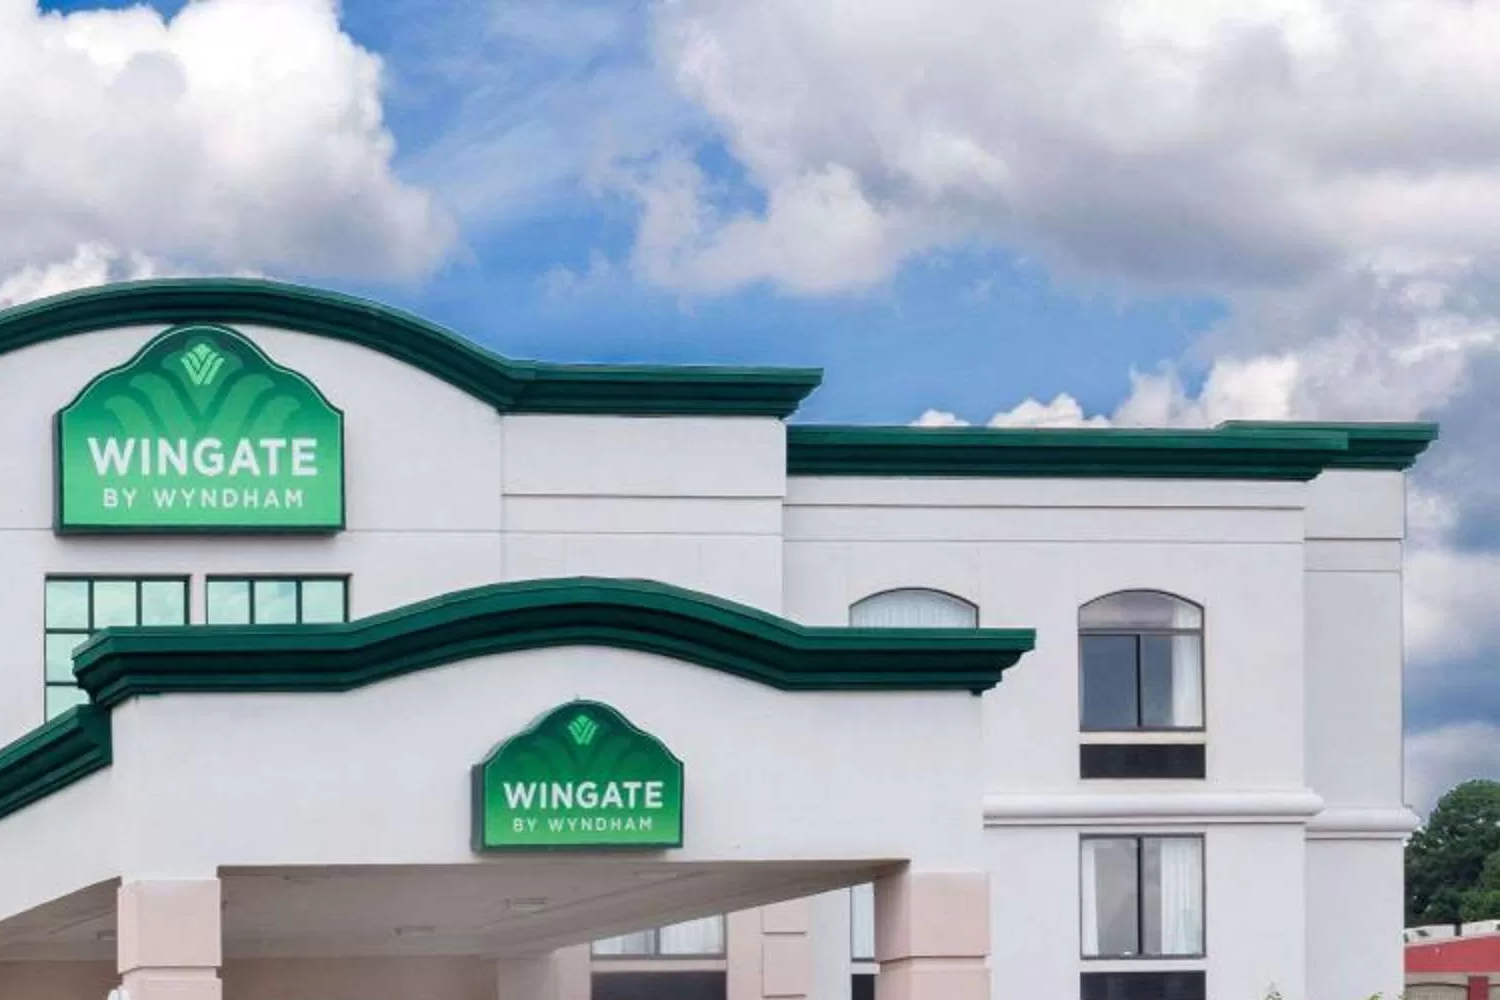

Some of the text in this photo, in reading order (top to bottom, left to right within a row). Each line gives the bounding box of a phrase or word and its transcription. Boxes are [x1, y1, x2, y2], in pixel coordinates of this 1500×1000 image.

[87, 437, 318, 476] WINGATE
[103, 488, 304, 508] BY WYNDHAM
[503, 781, 664, 809] WINGATE
[513, 817, 653, 832] BY WYNDHAM
